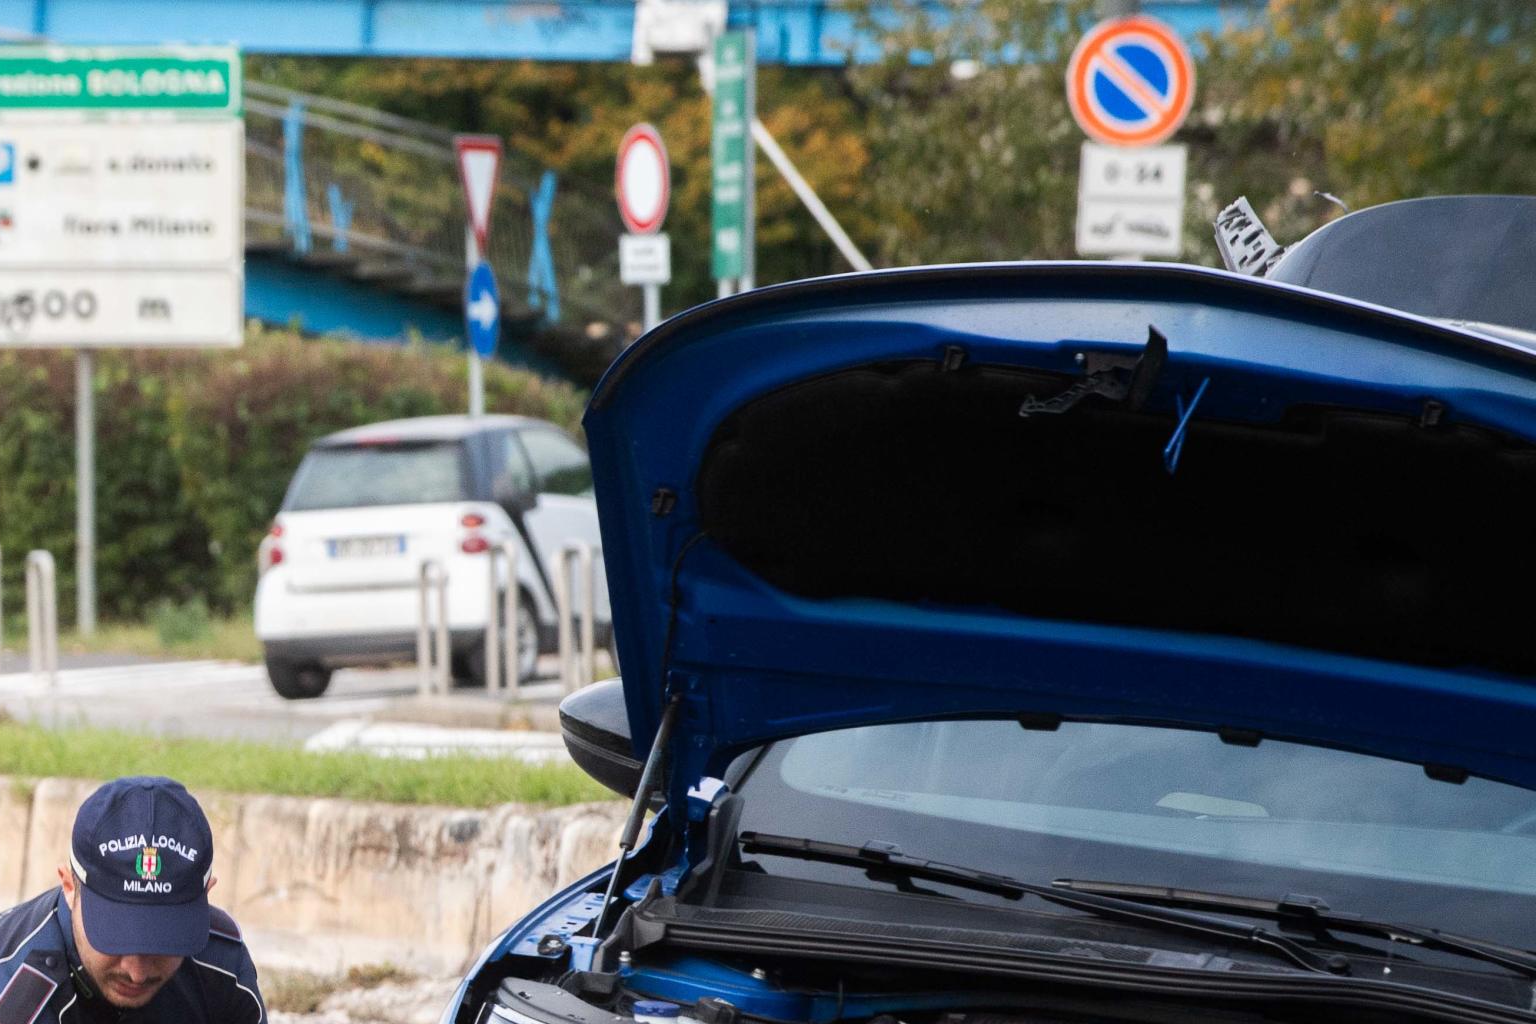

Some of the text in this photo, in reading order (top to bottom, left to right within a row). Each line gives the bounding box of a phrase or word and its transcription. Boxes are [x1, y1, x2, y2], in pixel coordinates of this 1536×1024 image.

[88, 68, 226, 96] BOLOGNA
[98, 834, 198, 862] POLIZIA LOCALE
[123, 880, 172, 893] MILANO
